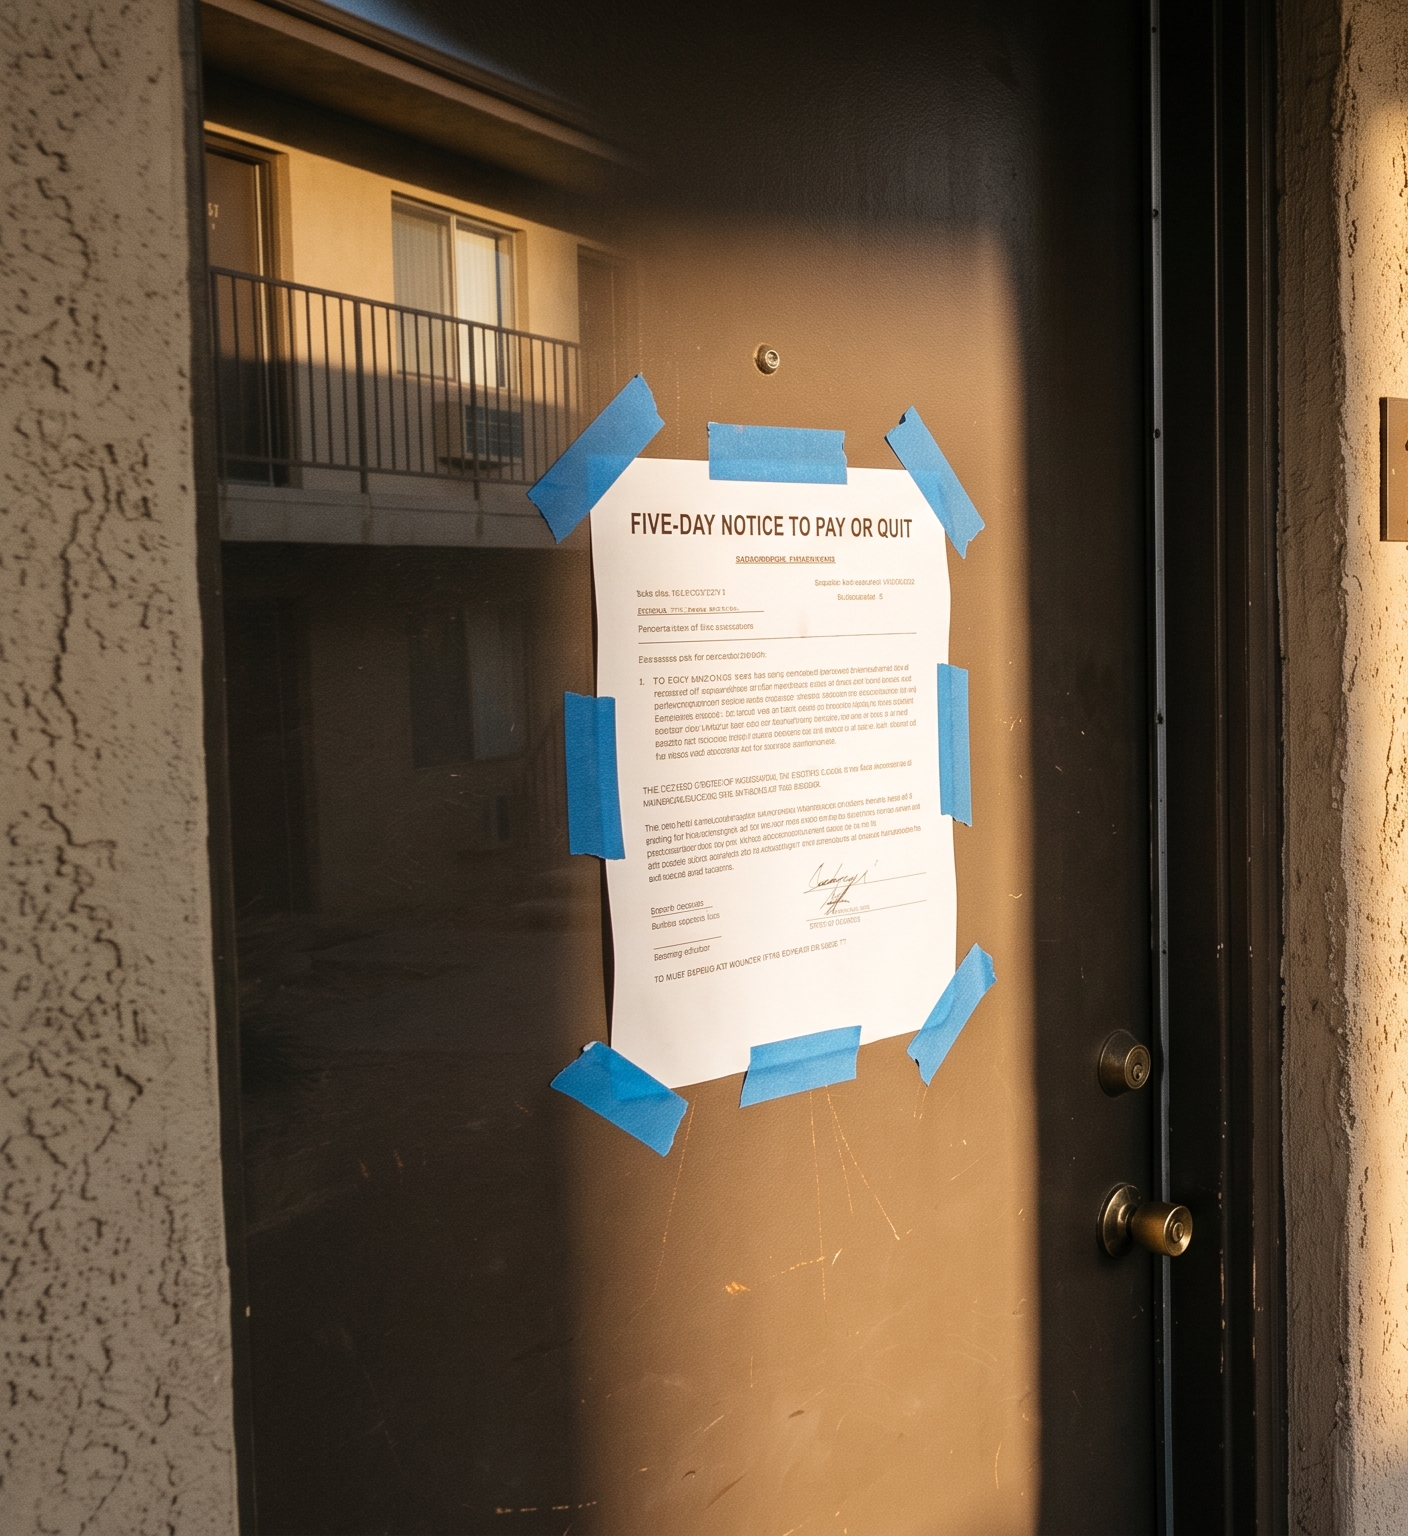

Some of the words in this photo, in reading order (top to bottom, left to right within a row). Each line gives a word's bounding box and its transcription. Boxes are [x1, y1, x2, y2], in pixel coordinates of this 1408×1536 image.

[631, 512, 716, 536] FIVE-DAY
[721, 514, 784, 536] NOTICE
[788, 516, 811, 537] TO
[816, 516, 846, 537] PAY
[850, 517, 873, 538] OR
[877, 518, 913, 539] QUIT
